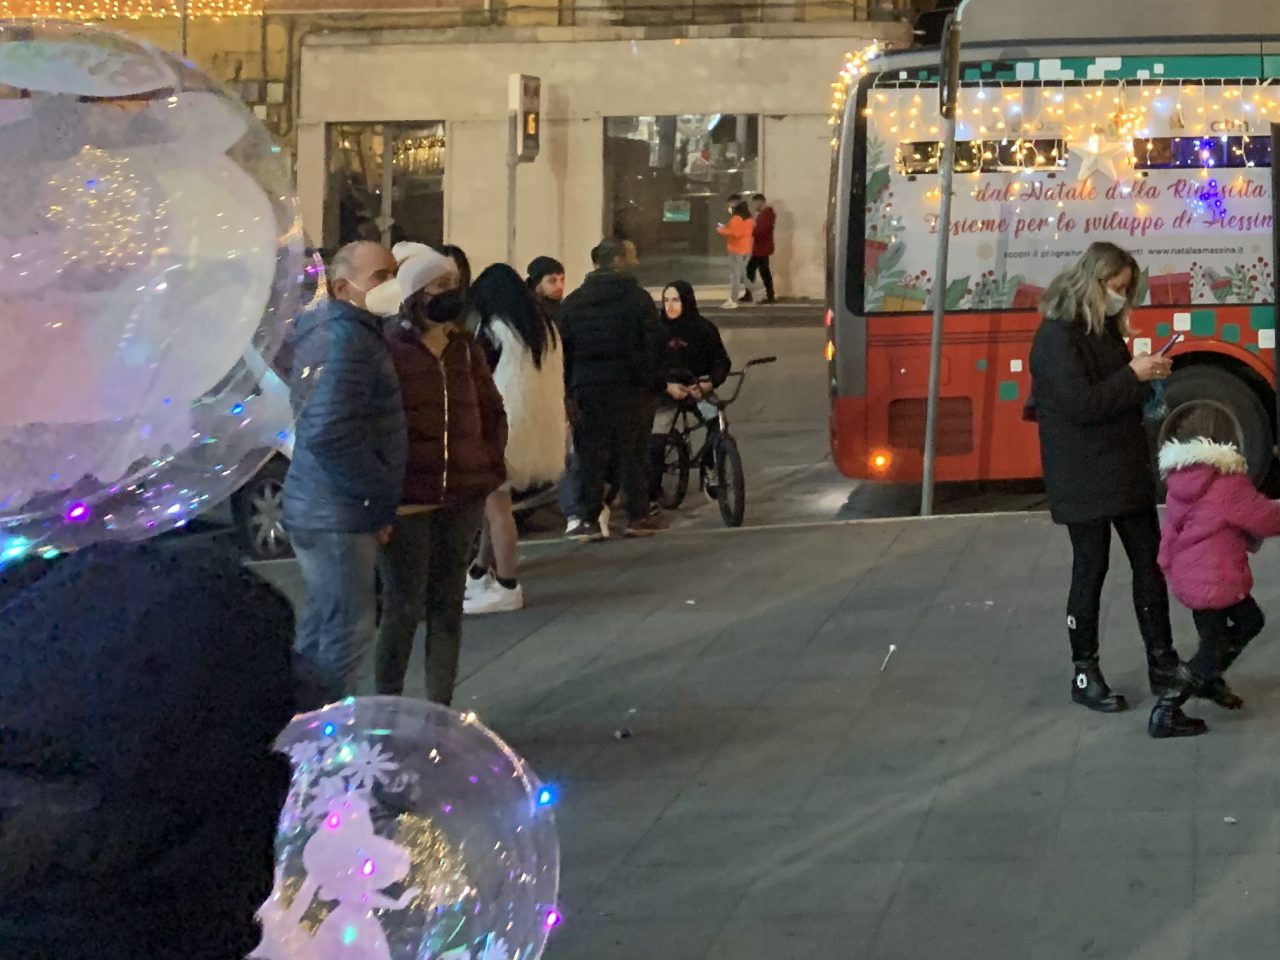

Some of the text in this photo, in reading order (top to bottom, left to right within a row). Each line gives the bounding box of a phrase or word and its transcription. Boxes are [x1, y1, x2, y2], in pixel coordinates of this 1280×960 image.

[976, 182, 1013, 202] dal
[1019, 181, 1097, 201] Natale
[924, 213, 1009, 236] Isieme
[1015, 218, 1050, 239] per
[1057, 211, 1077, 232] lo
[1084, 211, 1166, 236] sviluppo
[1004, 250, 1031, 258] scopri
